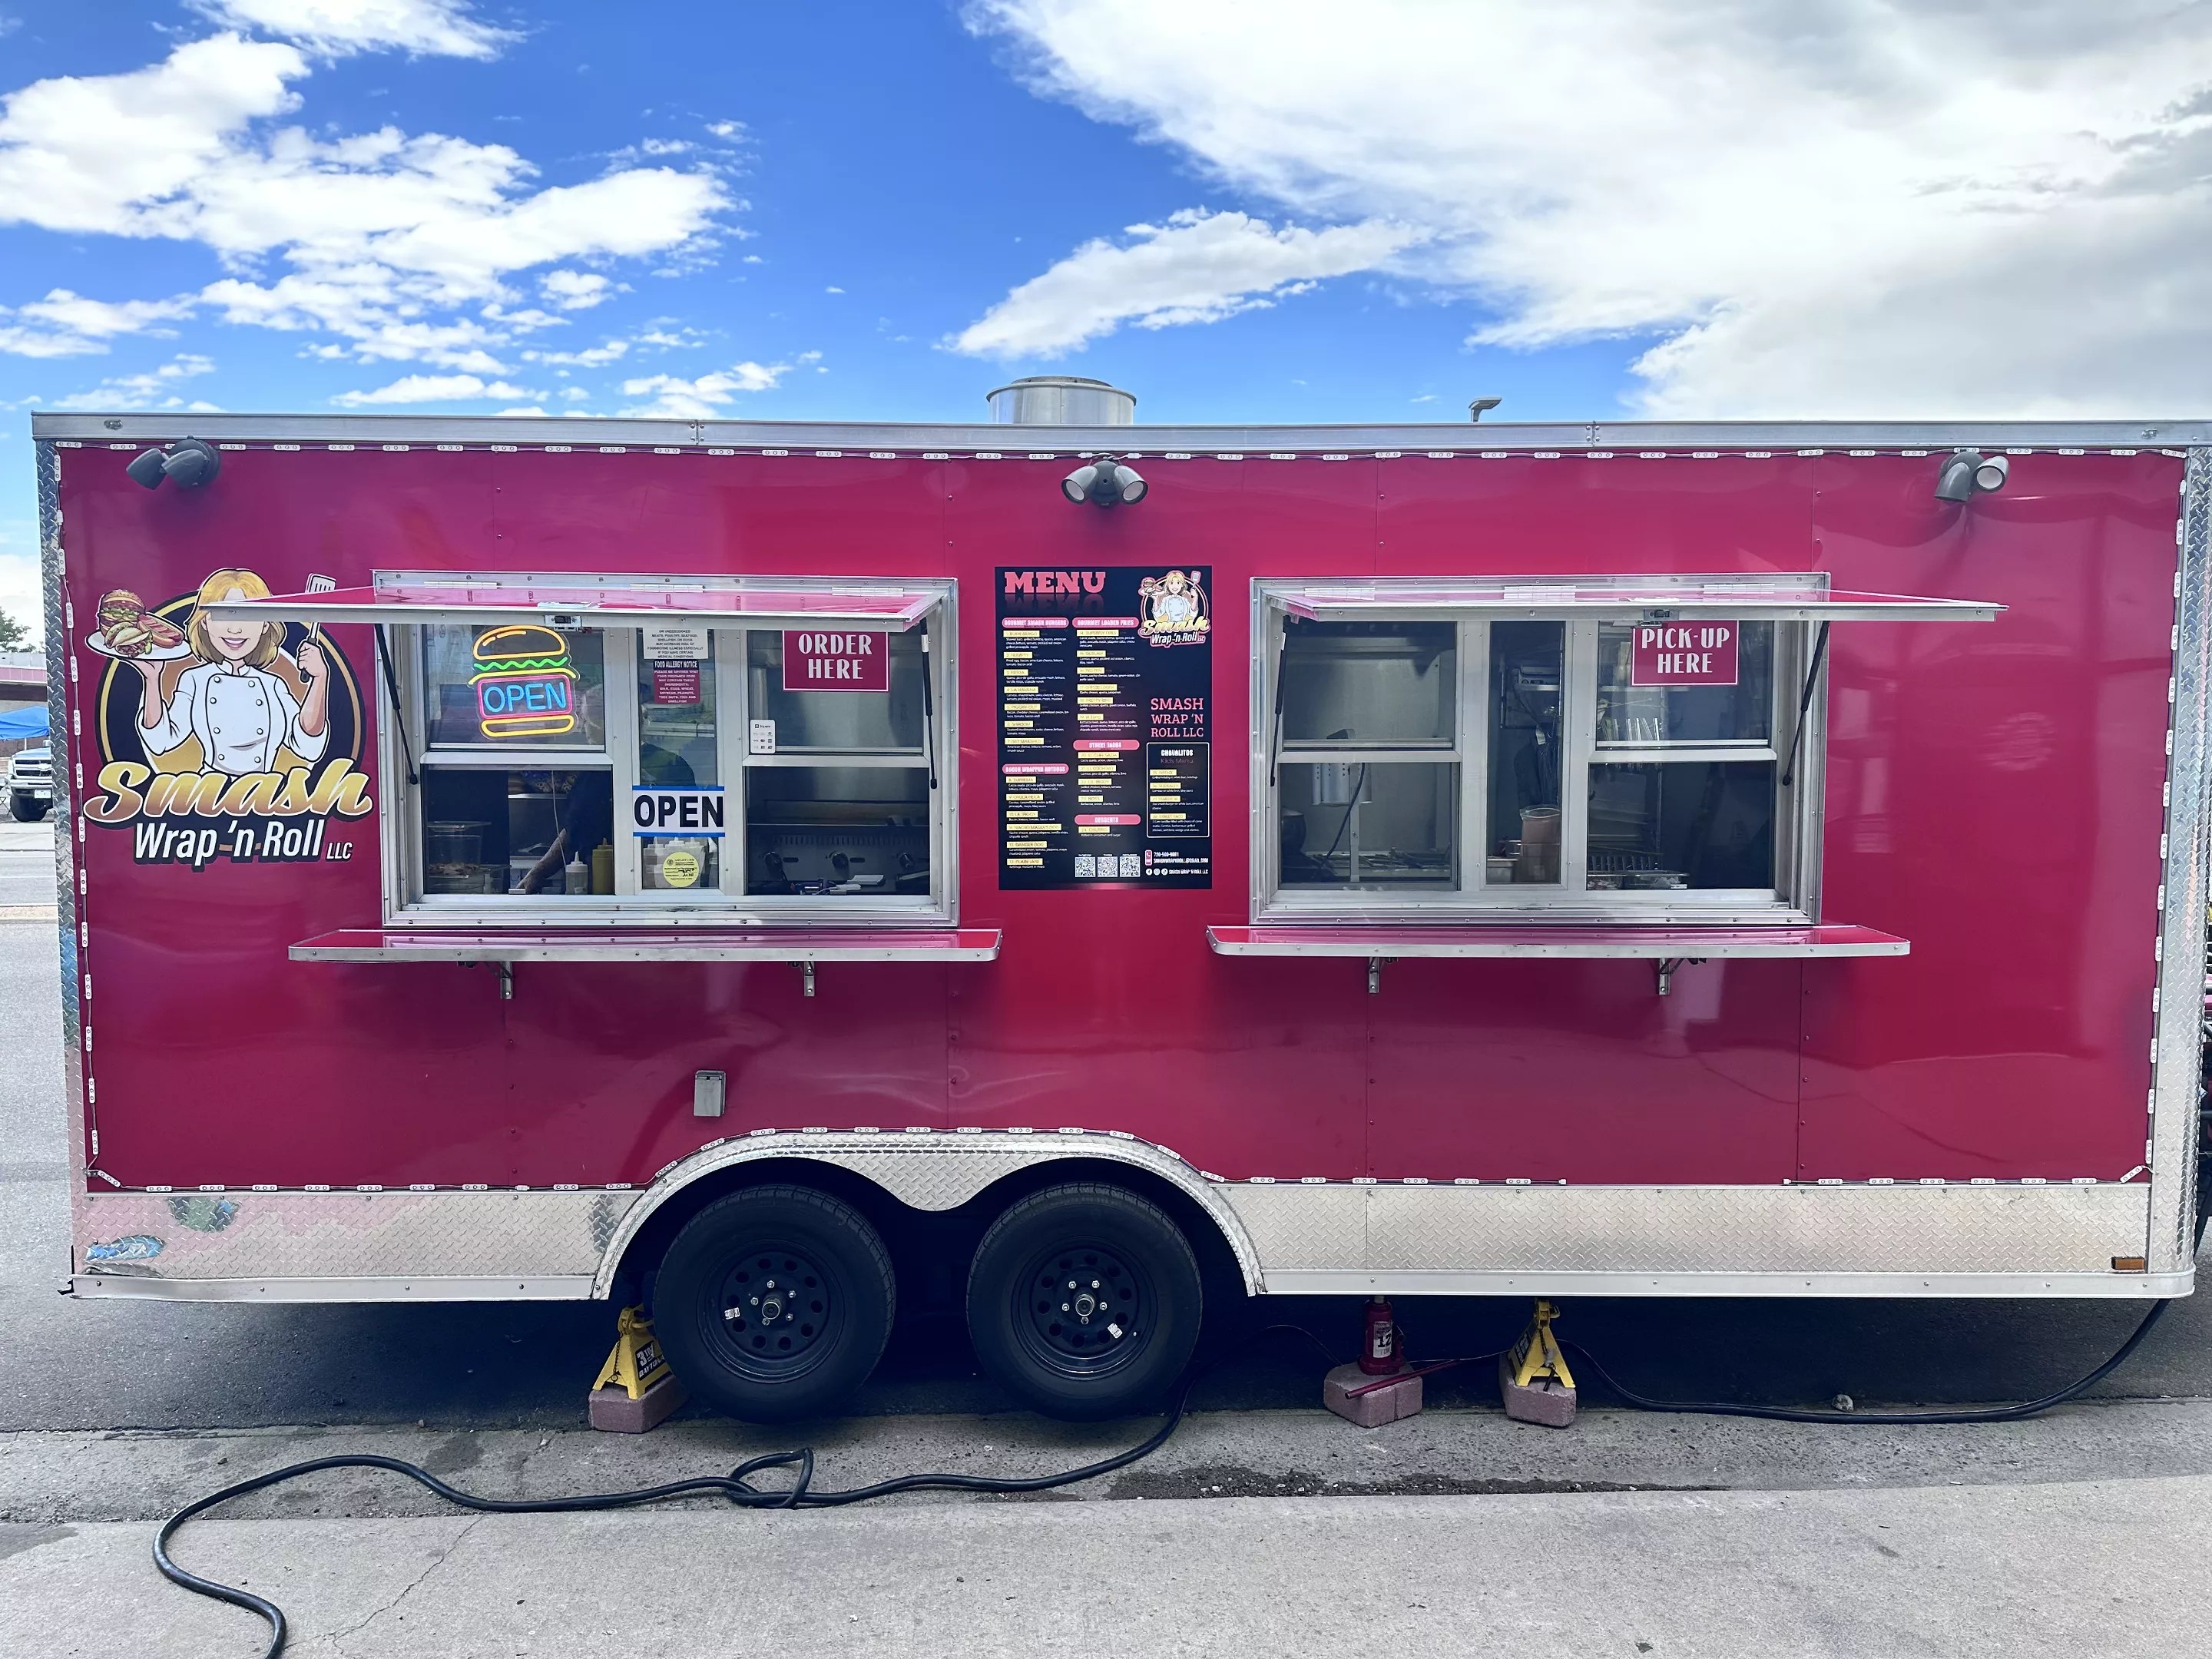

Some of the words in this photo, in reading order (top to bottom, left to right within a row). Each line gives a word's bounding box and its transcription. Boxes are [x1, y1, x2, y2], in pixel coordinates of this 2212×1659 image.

[1005, 572, 1105, 593] MENU
[1139, 616, 1210, 636] Smash
[799, 634, 872, 654] ORDER
[1152, 634, 1171, 644] Wrap
[1182, 631, 1197, 641] Roll
[1642, 628, 1730, 648] PICK-UP
[808, 659, 863, 679] HERE
[1657, 653, 1713, 673] HERE
[484, 682, 566, 712] OPEN
[1151, 698, 1204, 710] SMASH
[1151, 714, 1188, 724] WRAP
[1151, 728, 1180, 737] ROLL
[1183, 728, 1204, 737] LLC
[83, 758, 373, 823] Smash
[634, 795, 724, 827] OPEN
[135, 823, 217, 866] Wrap
[228, 820, 256, 856] 'n
[262, 819, 325, 856] Roll
[326, 842, 352, 859] LLC
[1378, 1333, 1391, 1347] 12
[637, 1351, 647, 1366] 3
